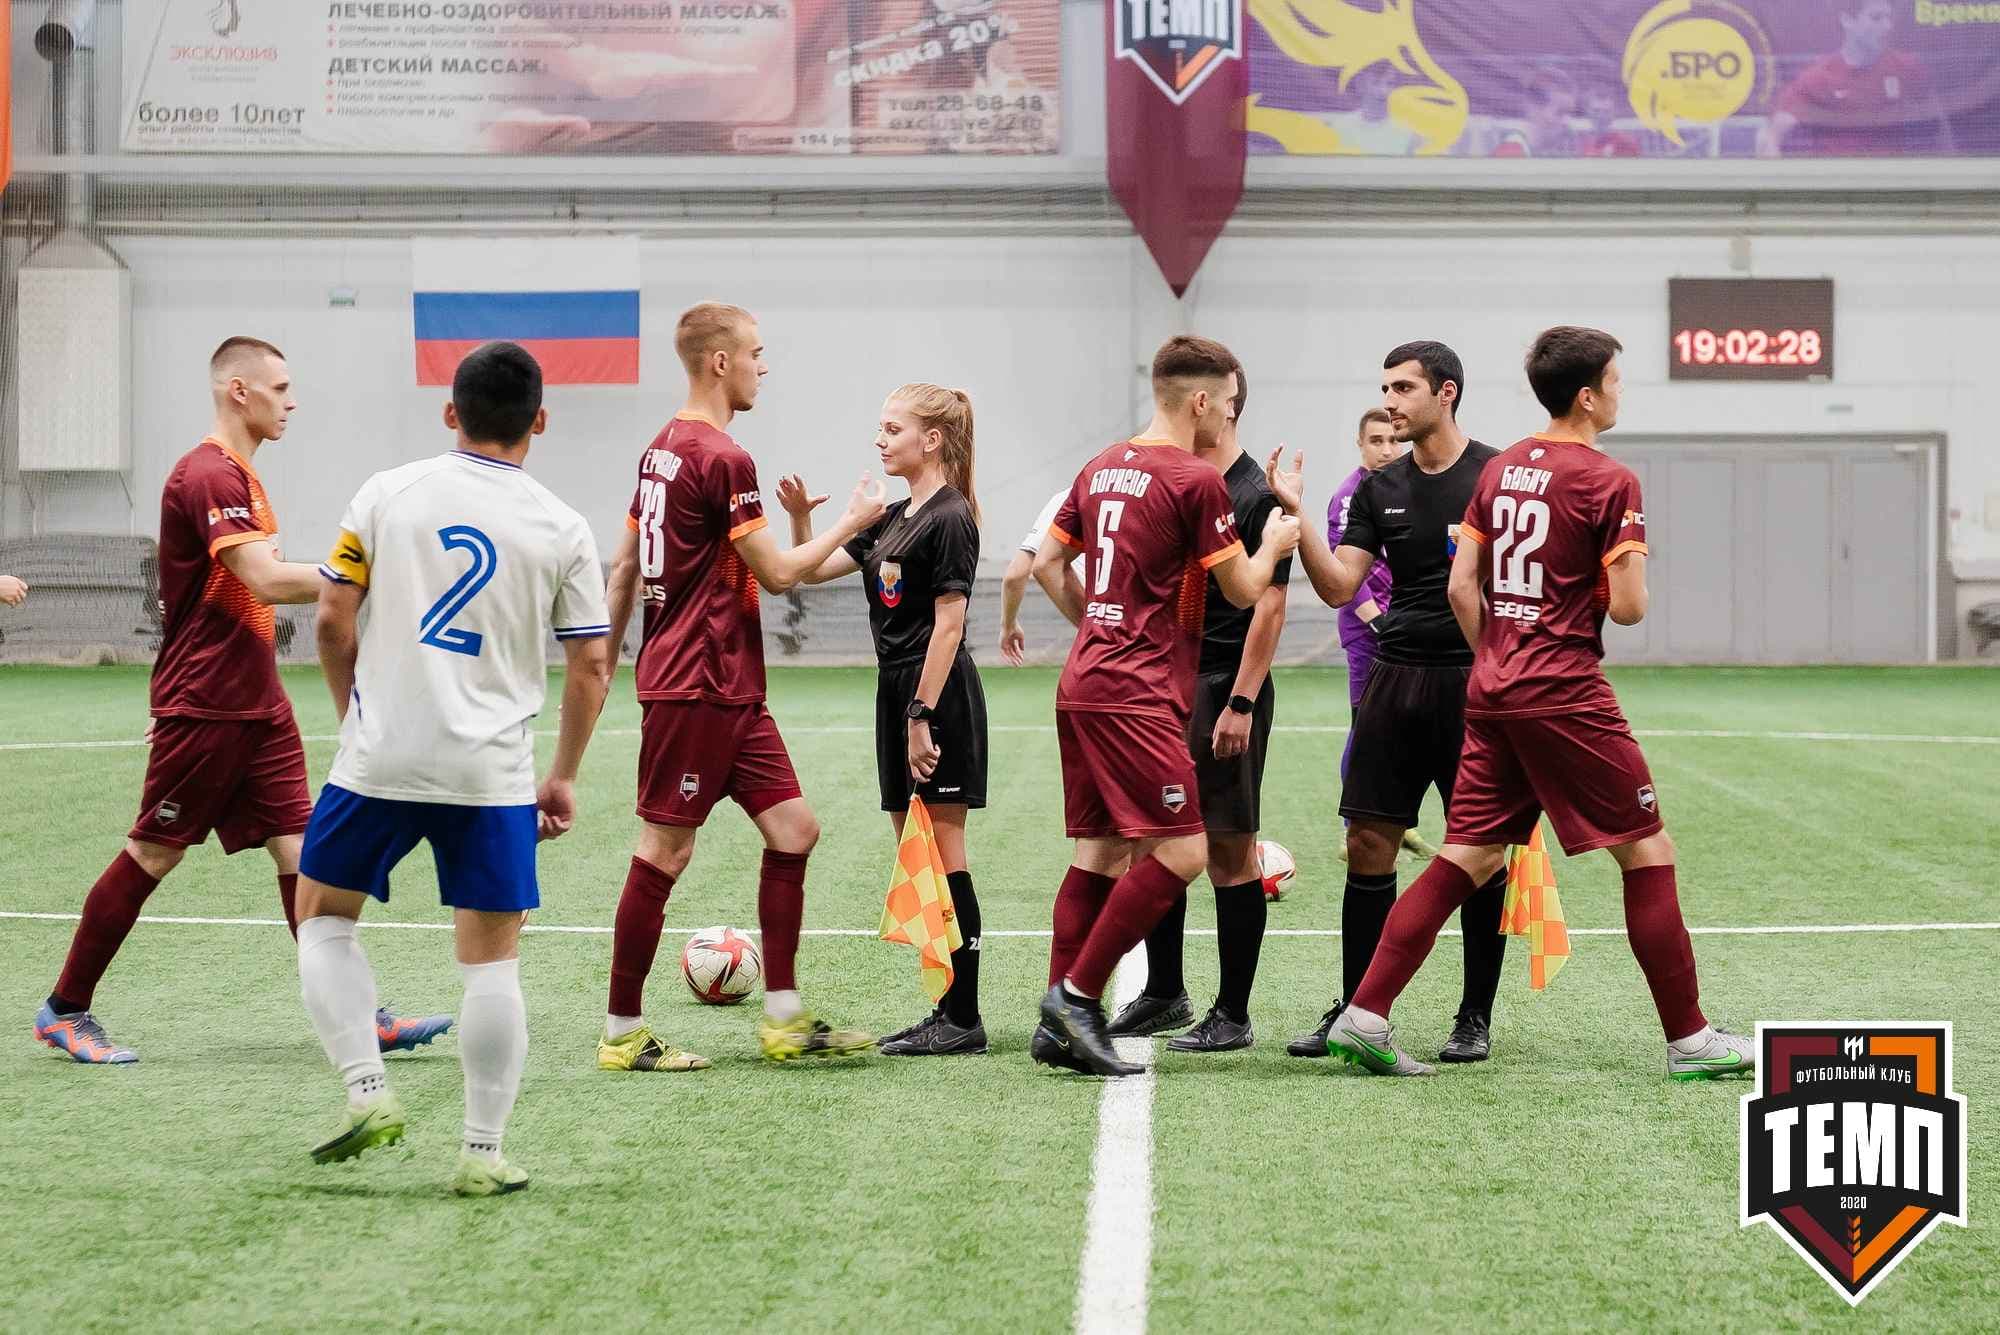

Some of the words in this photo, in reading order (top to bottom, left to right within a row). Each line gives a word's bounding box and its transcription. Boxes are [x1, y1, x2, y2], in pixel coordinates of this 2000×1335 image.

[327, 2, 672, 21] ЛЕЧЕБНО-ОЗДОРОВИТЕЛЬНЫЙ
[679, 4, 788, 20] МАССАЖ:
[170, 46, 278, 62] ЭКСКЛЮЗИВ
[328, 54, 433, 75] ДЕТСКИЙ
[441, 58, 549, 74] МАССАЖ:
[138, 101, 219, 123] более
[231, 103, 305, 124] 10лет
[1674, 329, 1822, 366] 19:02:28
[1089, 468, 1152, 498] БОРИСОВ
[1500, 465, 1553, 496] БАБИЧ
[639, 478, 667, 579] 33
[1094, 500, 1125, 596] 5
[1492, 495, 1551, 600] 22
[418, 524, 497, 658] 2
